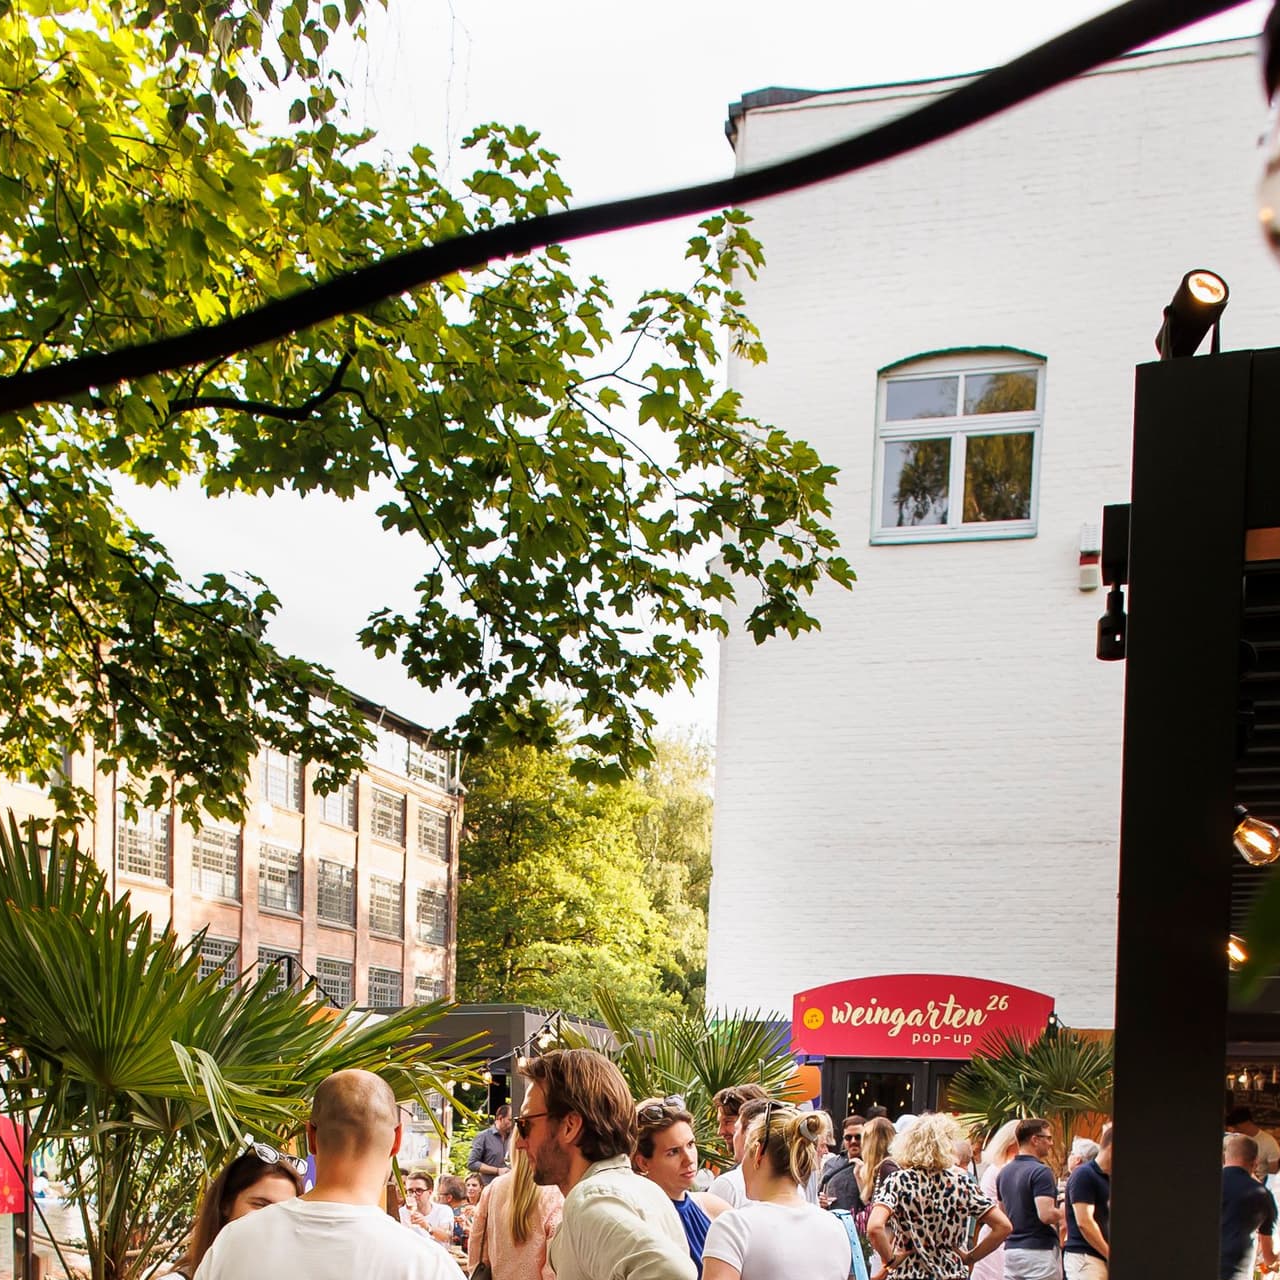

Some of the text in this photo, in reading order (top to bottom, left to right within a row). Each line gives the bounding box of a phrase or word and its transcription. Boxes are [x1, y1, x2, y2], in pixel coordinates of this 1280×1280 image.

[831, 994, 1010, 1037] weingarten 26
[912, 1032, 973, 1046] pop-up
